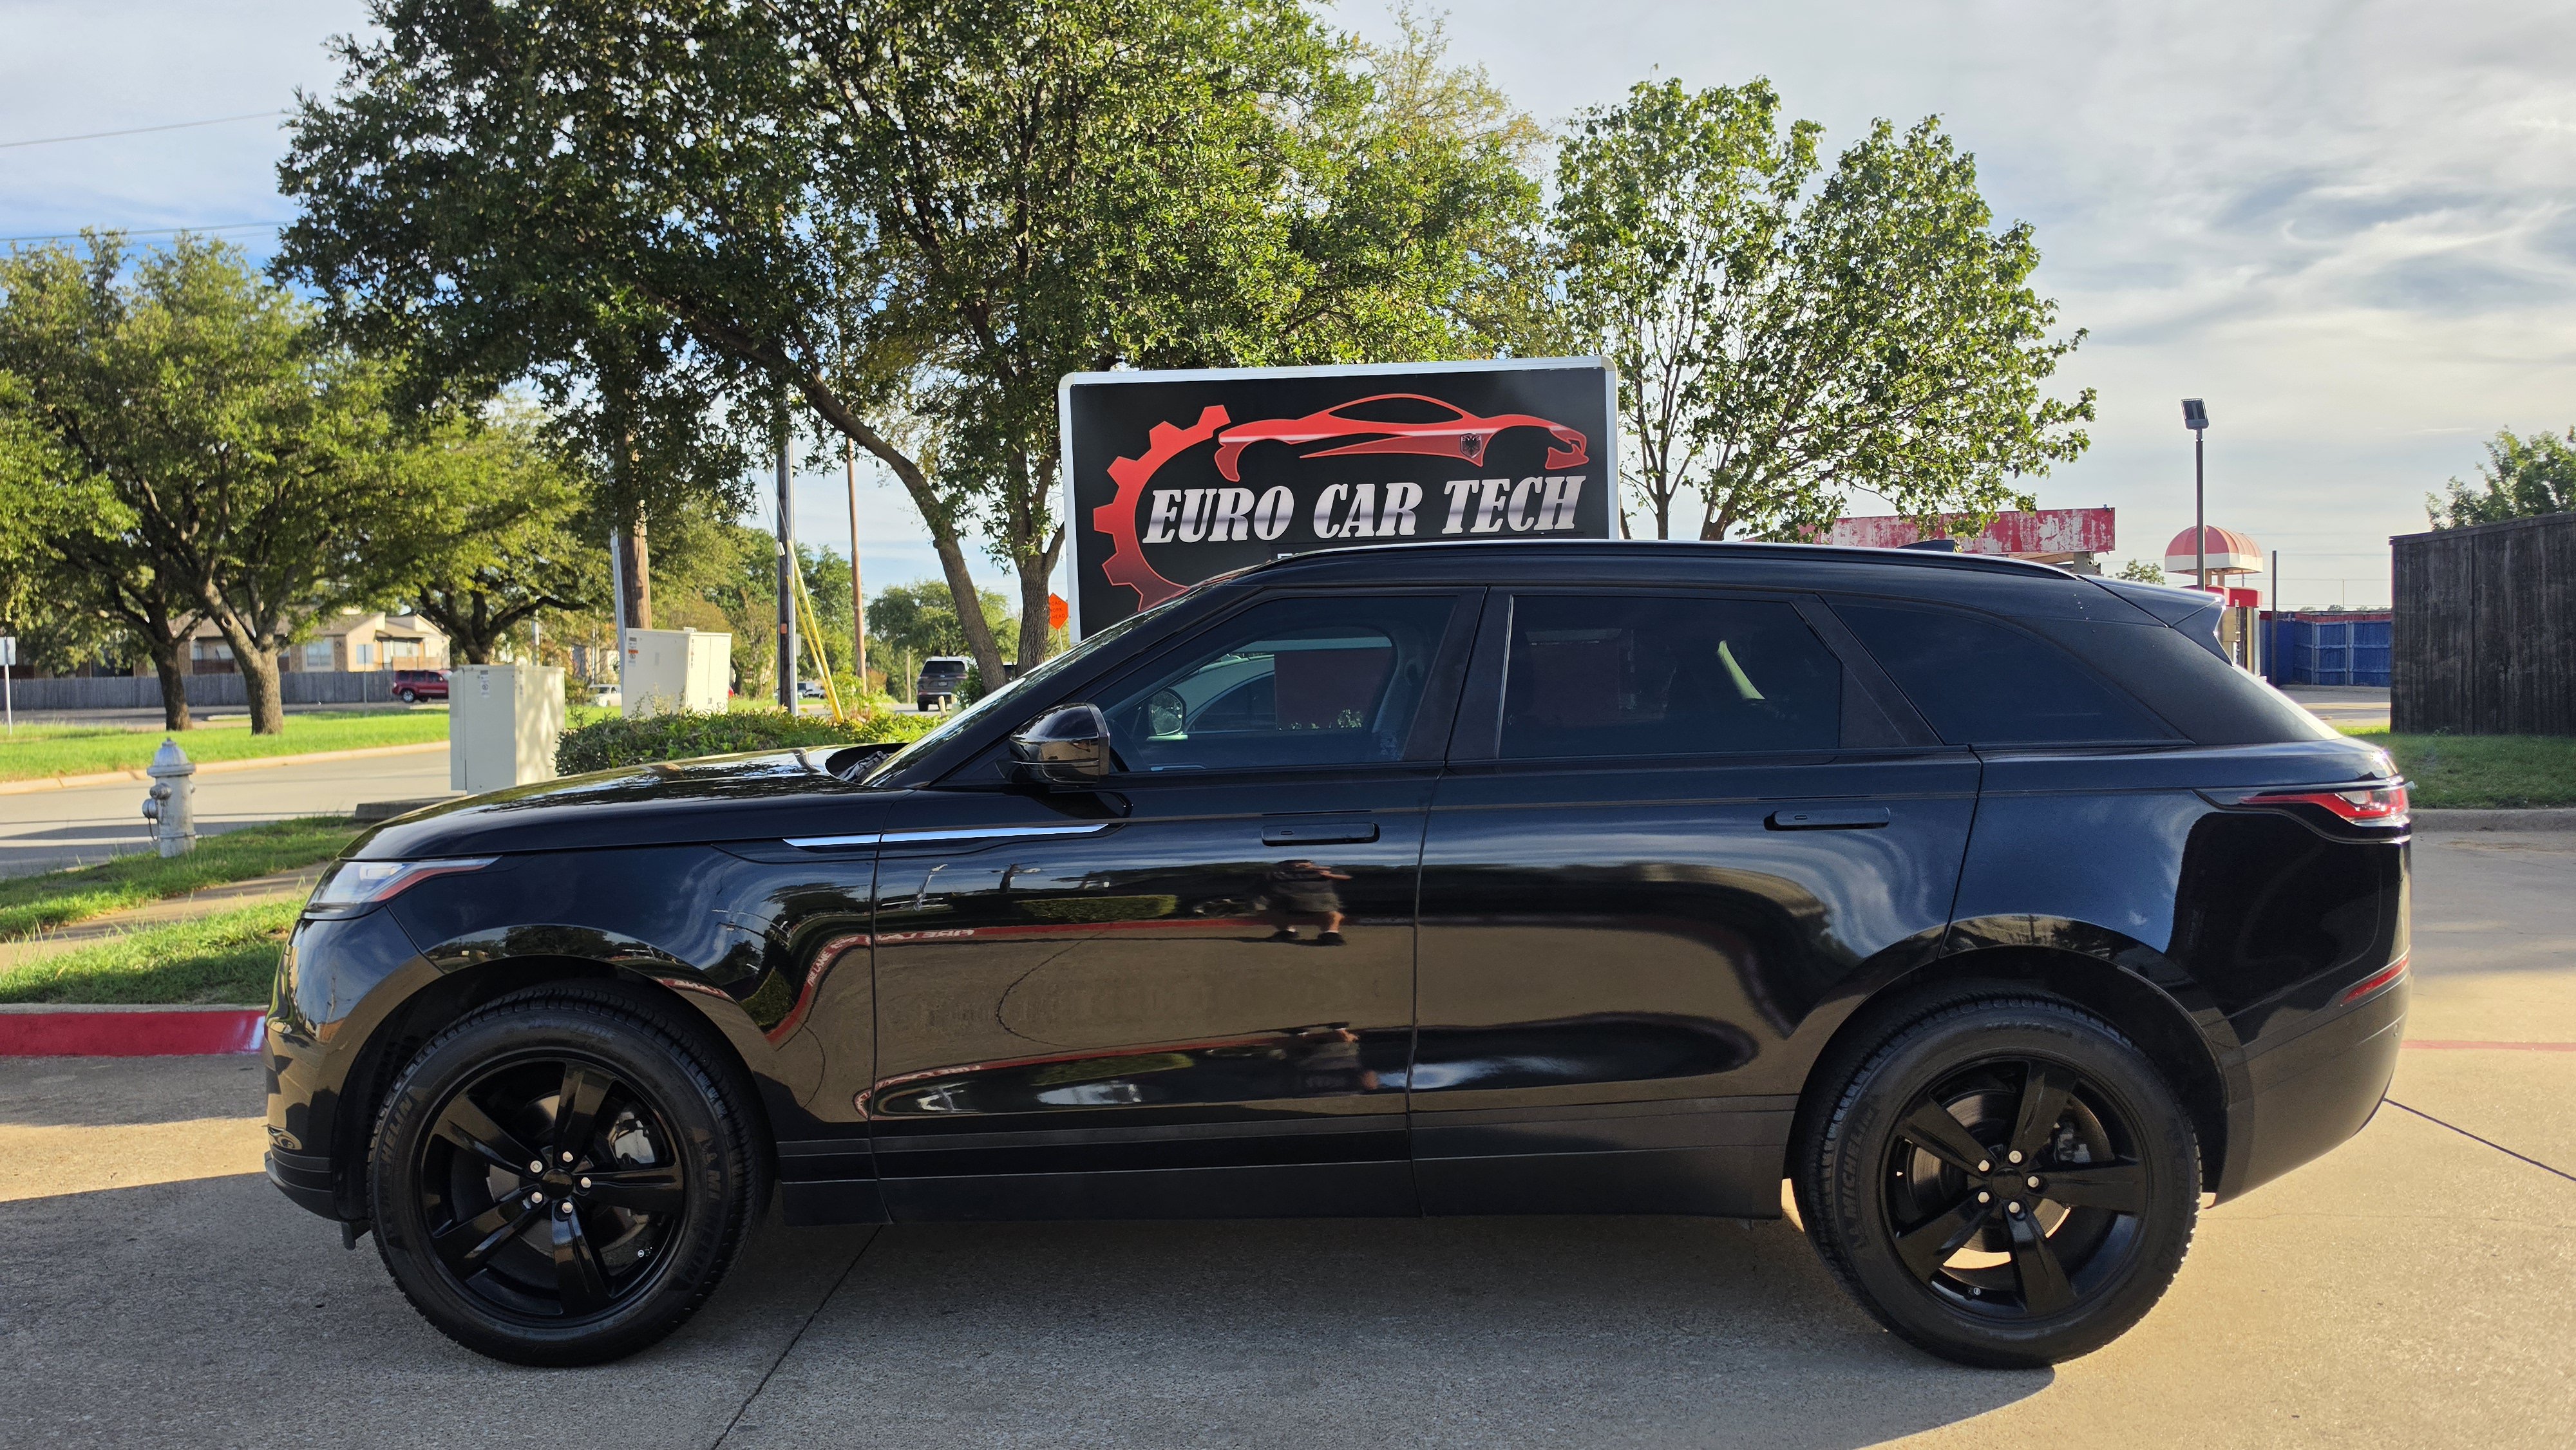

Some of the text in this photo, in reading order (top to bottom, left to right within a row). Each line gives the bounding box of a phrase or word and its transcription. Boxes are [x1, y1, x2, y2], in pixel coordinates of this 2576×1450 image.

[1142, 476, 1587, 543] EURO CAR TECH
